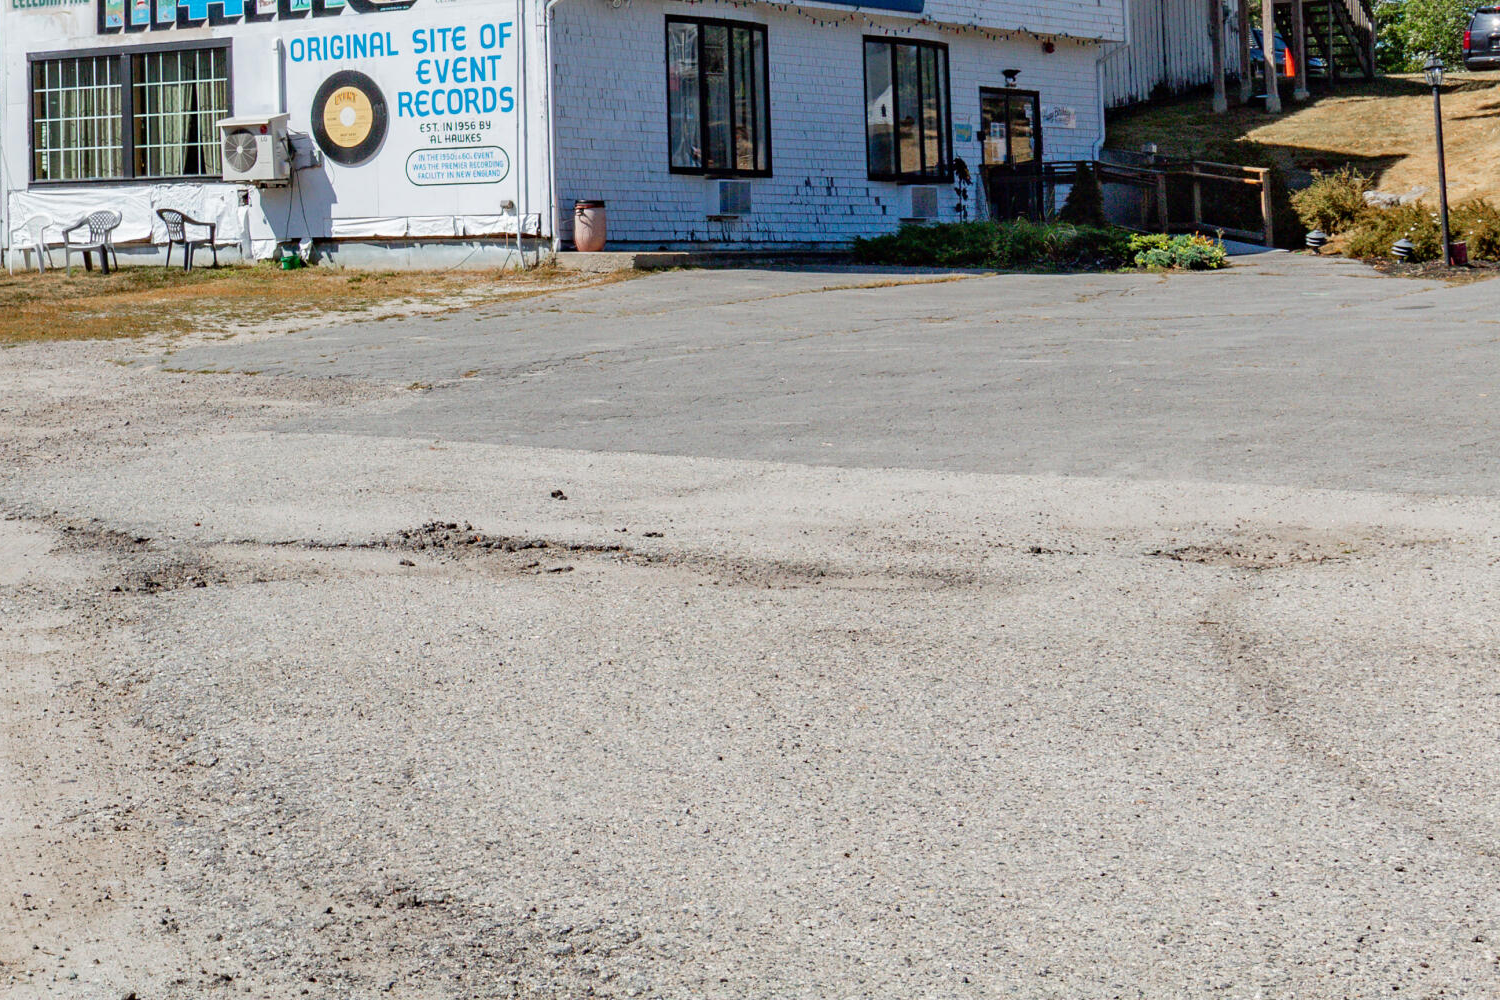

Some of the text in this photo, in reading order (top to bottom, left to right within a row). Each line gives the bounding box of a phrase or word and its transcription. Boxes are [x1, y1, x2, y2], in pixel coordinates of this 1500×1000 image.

[290, 21, 513, 62] ORIGINAL SITE OF
[415, 55, 502, 85] EVENT
[397, 86, 515, 118] RECORDS
[420, 120, 491, 133] EST. IN 1956 BY
[430, 133, 482, 144] AL HAWKES
[419, 154, 425, 162] IN
[427, 153, 438, 161] THE
[473, 152, 494, 160] EVENT
[413, 160, 504, 171] WAS THE PREMIER RECORDING
[417, 169, 501, 180] FACILITY IN NEW ENGLAND
